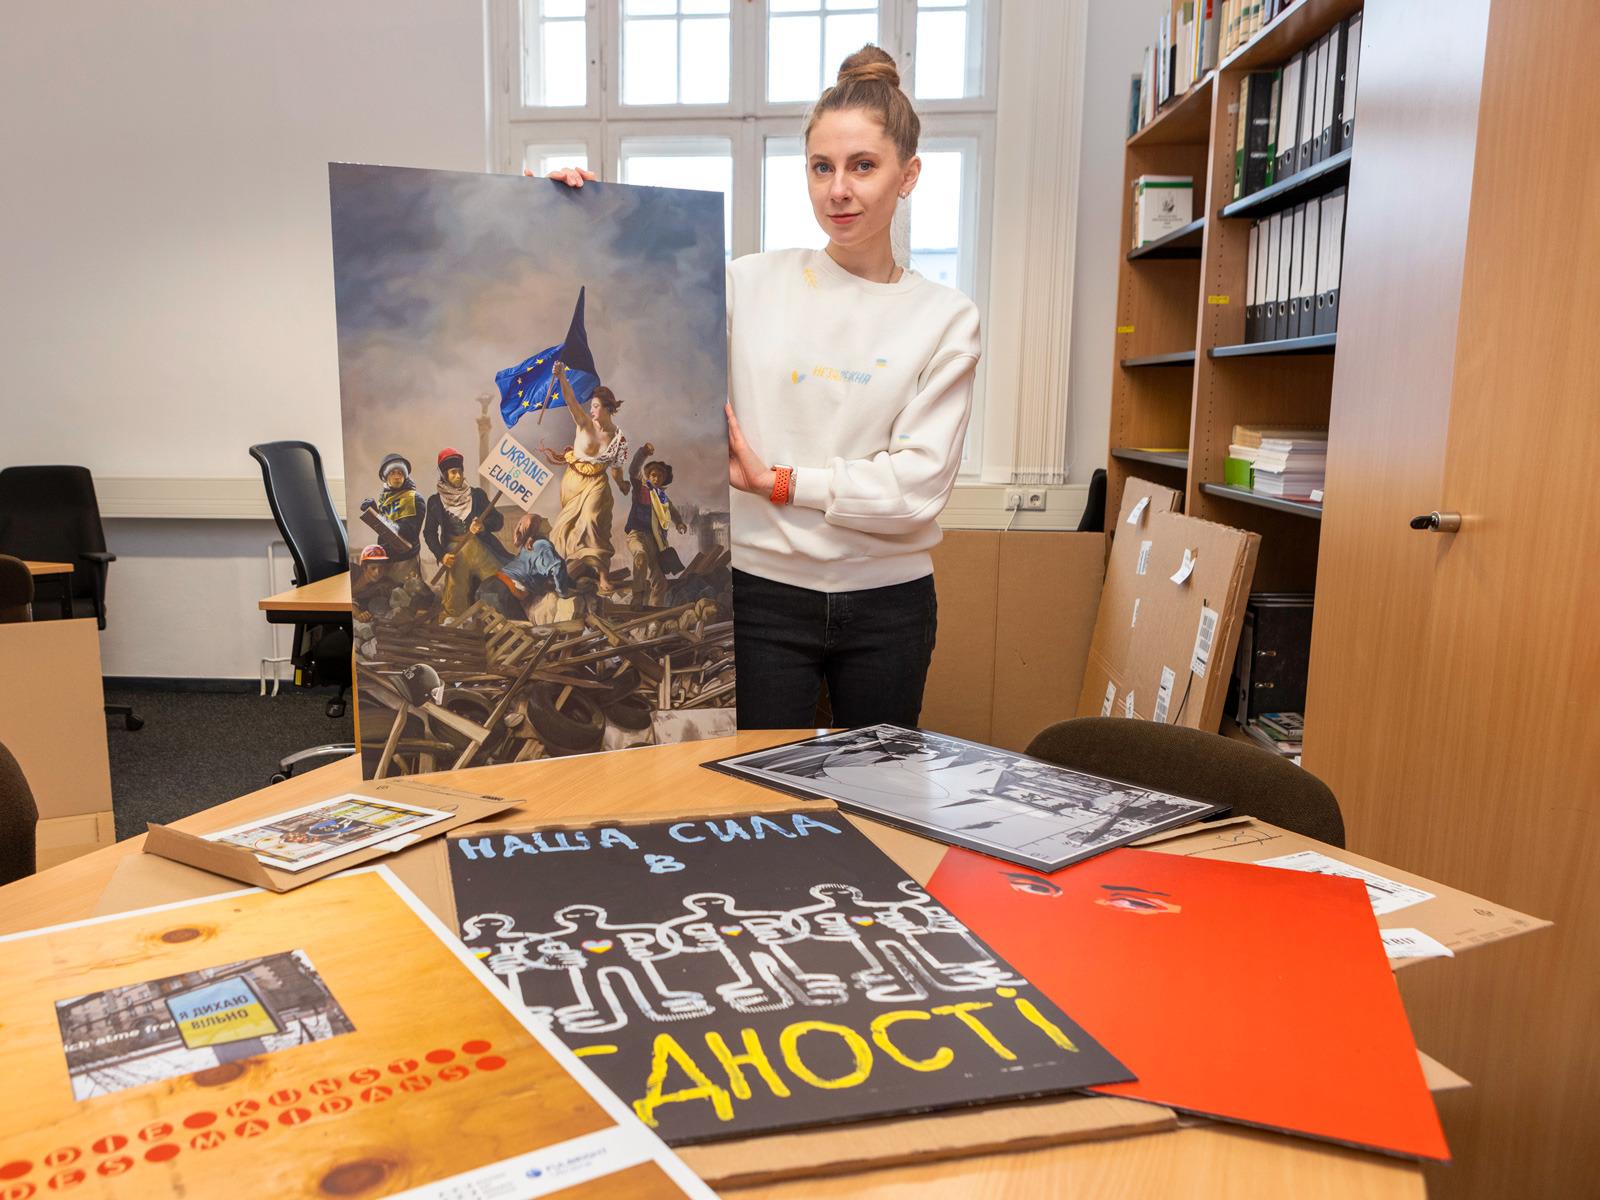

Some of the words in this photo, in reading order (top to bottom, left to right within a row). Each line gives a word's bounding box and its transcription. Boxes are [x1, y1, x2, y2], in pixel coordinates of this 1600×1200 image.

[489, 464, 533, 503] EUROPE
[500, 440, 548, 486] UKRAINE
[458, 827, 639, 860] НАША
[668, 813, 842, 843] СИЛА
[643, 853, 686, 874] В
[178, 1010, 189, 1021] Я
[192, 994, 249, 1018] ДИХАЮ
[190, 1010, 249, 1031] ВІЛЬНО
[95, 1028, 141, 1046] atme
[574, 986, 1079, 1127] ДНОСТІ
[1, 1156, 133, 1199] DES
[191, 1064, 469, 1151] MAIDANS
[46, 1123, 171, 1168] DIE
[228, 1058, 417, 1119] KUNST
